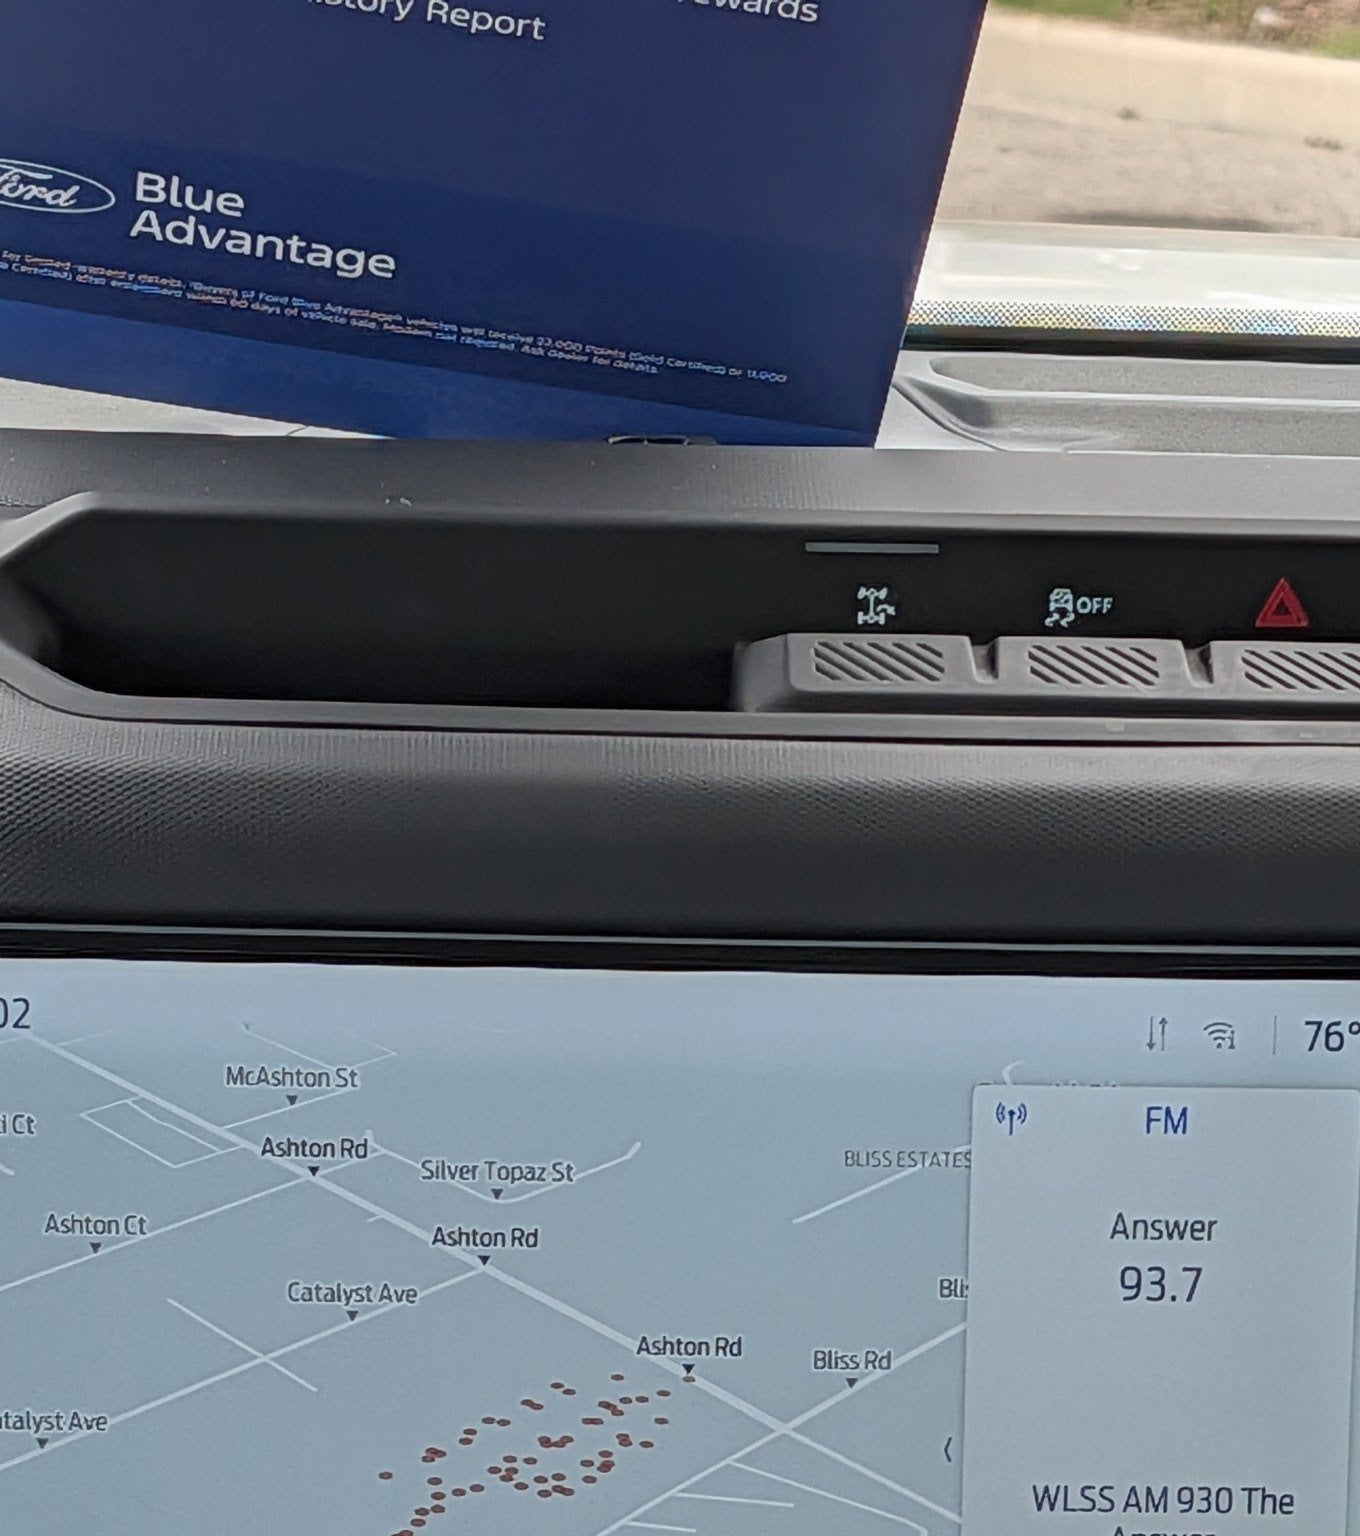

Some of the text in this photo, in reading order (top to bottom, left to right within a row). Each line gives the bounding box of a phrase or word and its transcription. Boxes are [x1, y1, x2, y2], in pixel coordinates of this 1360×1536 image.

[426, 0, 546, 41] Report
[135, 171, 245, 217] Blue
[129, 209, 397, 279] Advantage
[1076, 596, 1113, 616] OFF
[226, 1066, 358, 1089] McAshton St
[12, 1114, 35, 1134] Ct
[1145, 1105, 1189, 1135] FM
[261, 1137, 368, 1160] Ashton Rd
[844, 1151, 971, 1169] BLISS ESTATES
[421, 1160, 573, 1185] Silver Topaz St
[45, 1215, 147, 1236] Ashton Ct
[1110, 1212, 1218, 1242] Answer
[431, 1227, 539, 1248] Ashton Rd
[288, 1283, 418, 1307] Catalyst Ave
[940, 1278, 969, 1298] Bli
[1120, 1266, 1204, 1303] 93.7
[637, 1336, 743, 1358] Ashton Rd
[813, 1351, 892, 1372] Bliss Rd
[69, 1411, 107, 1431] Ave
[1033, 1484, 1295, 1517] WLSS AM 930 The
